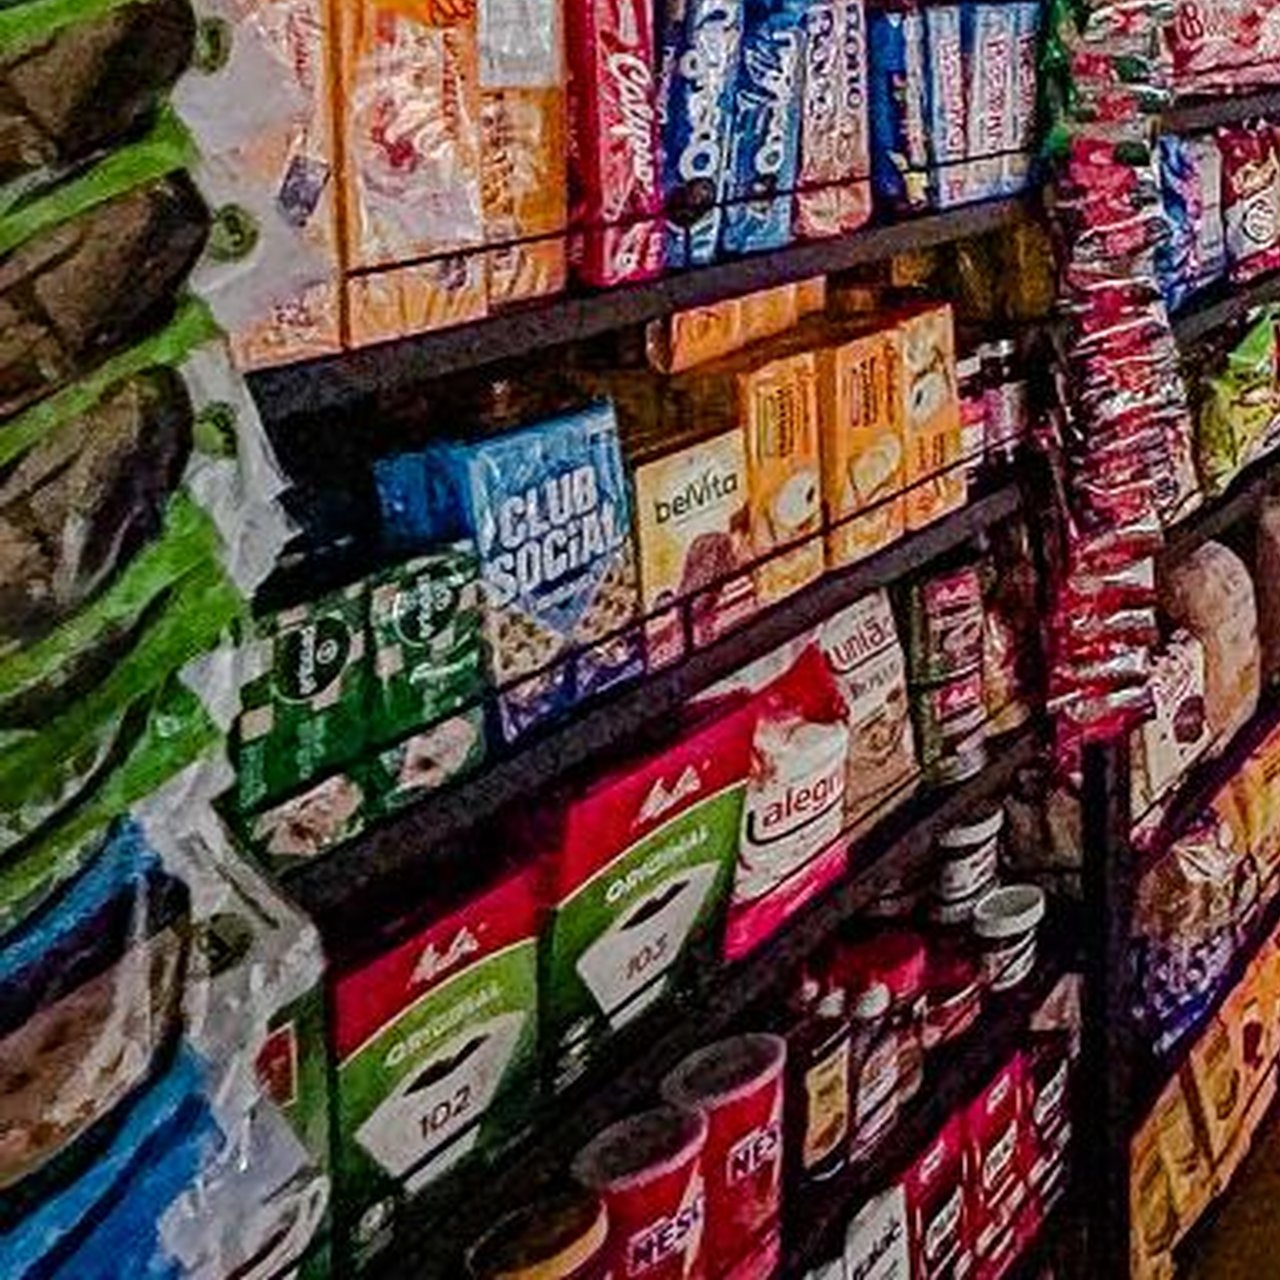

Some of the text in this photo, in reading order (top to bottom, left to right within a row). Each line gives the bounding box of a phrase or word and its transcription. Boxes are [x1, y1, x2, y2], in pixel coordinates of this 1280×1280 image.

[499, 465, 598, 549] CLUB
[655, 469, 738, 524] belVita
[420, 1084, 473, 1140] 102
